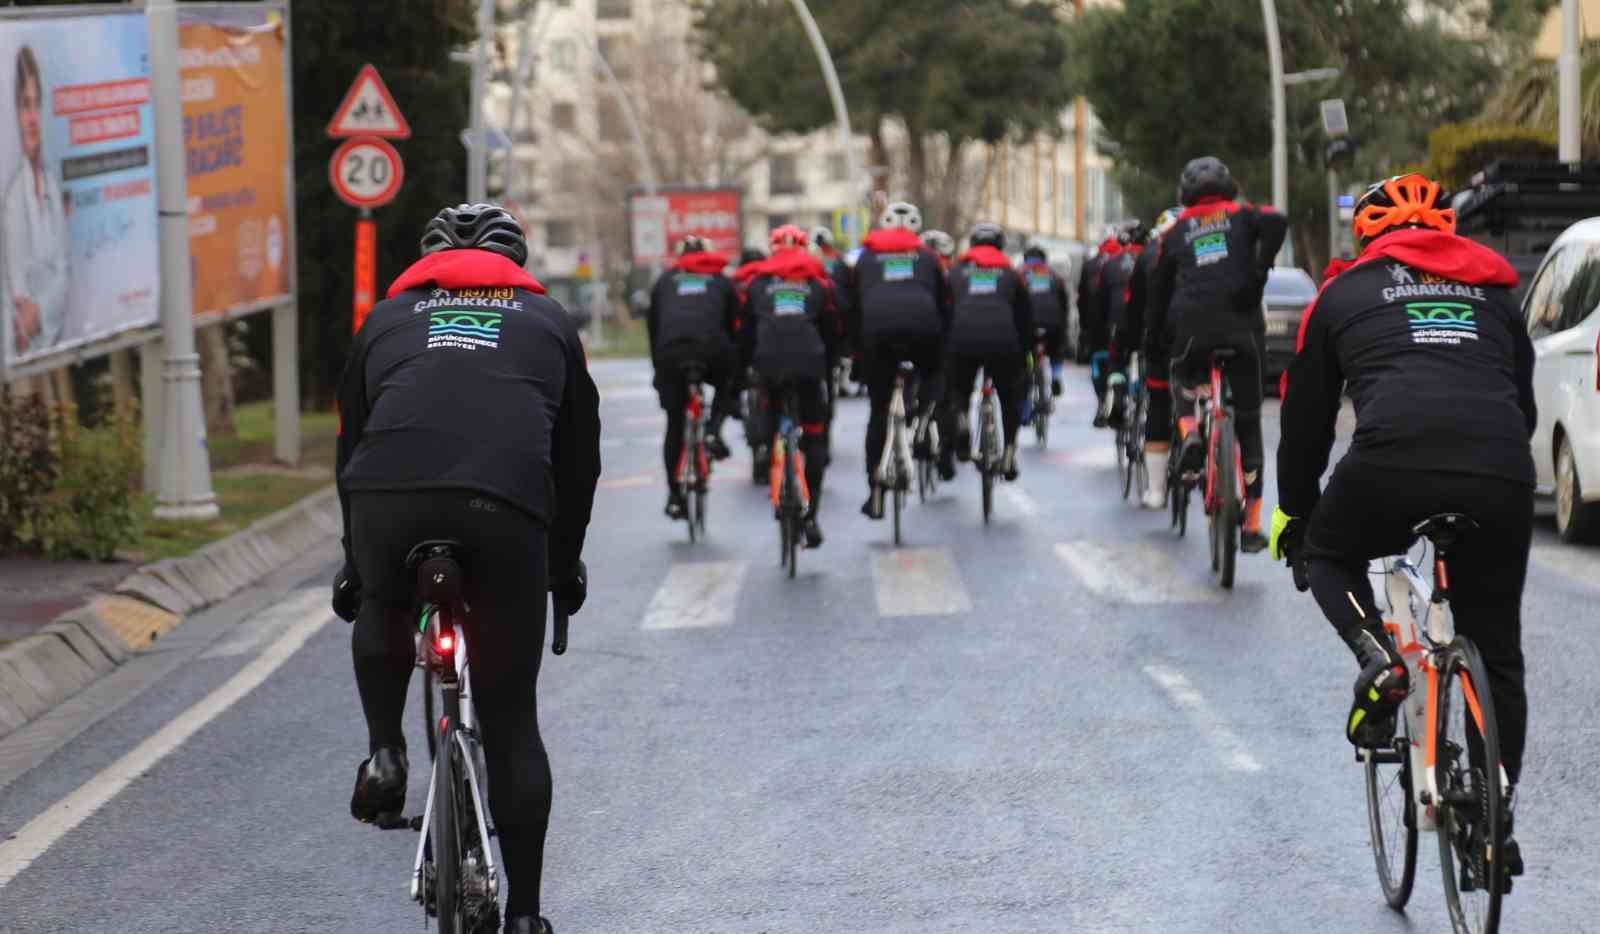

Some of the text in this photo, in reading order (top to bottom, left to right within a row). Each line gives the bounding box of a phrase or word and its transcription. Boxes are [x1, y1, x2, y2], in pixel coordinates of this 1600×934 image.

[347, 155, 389, 184] 20
[1382, 284, 1487, 303] ÇANAKKALE
[413, 297, 524, 313] ÇANAKKALE
